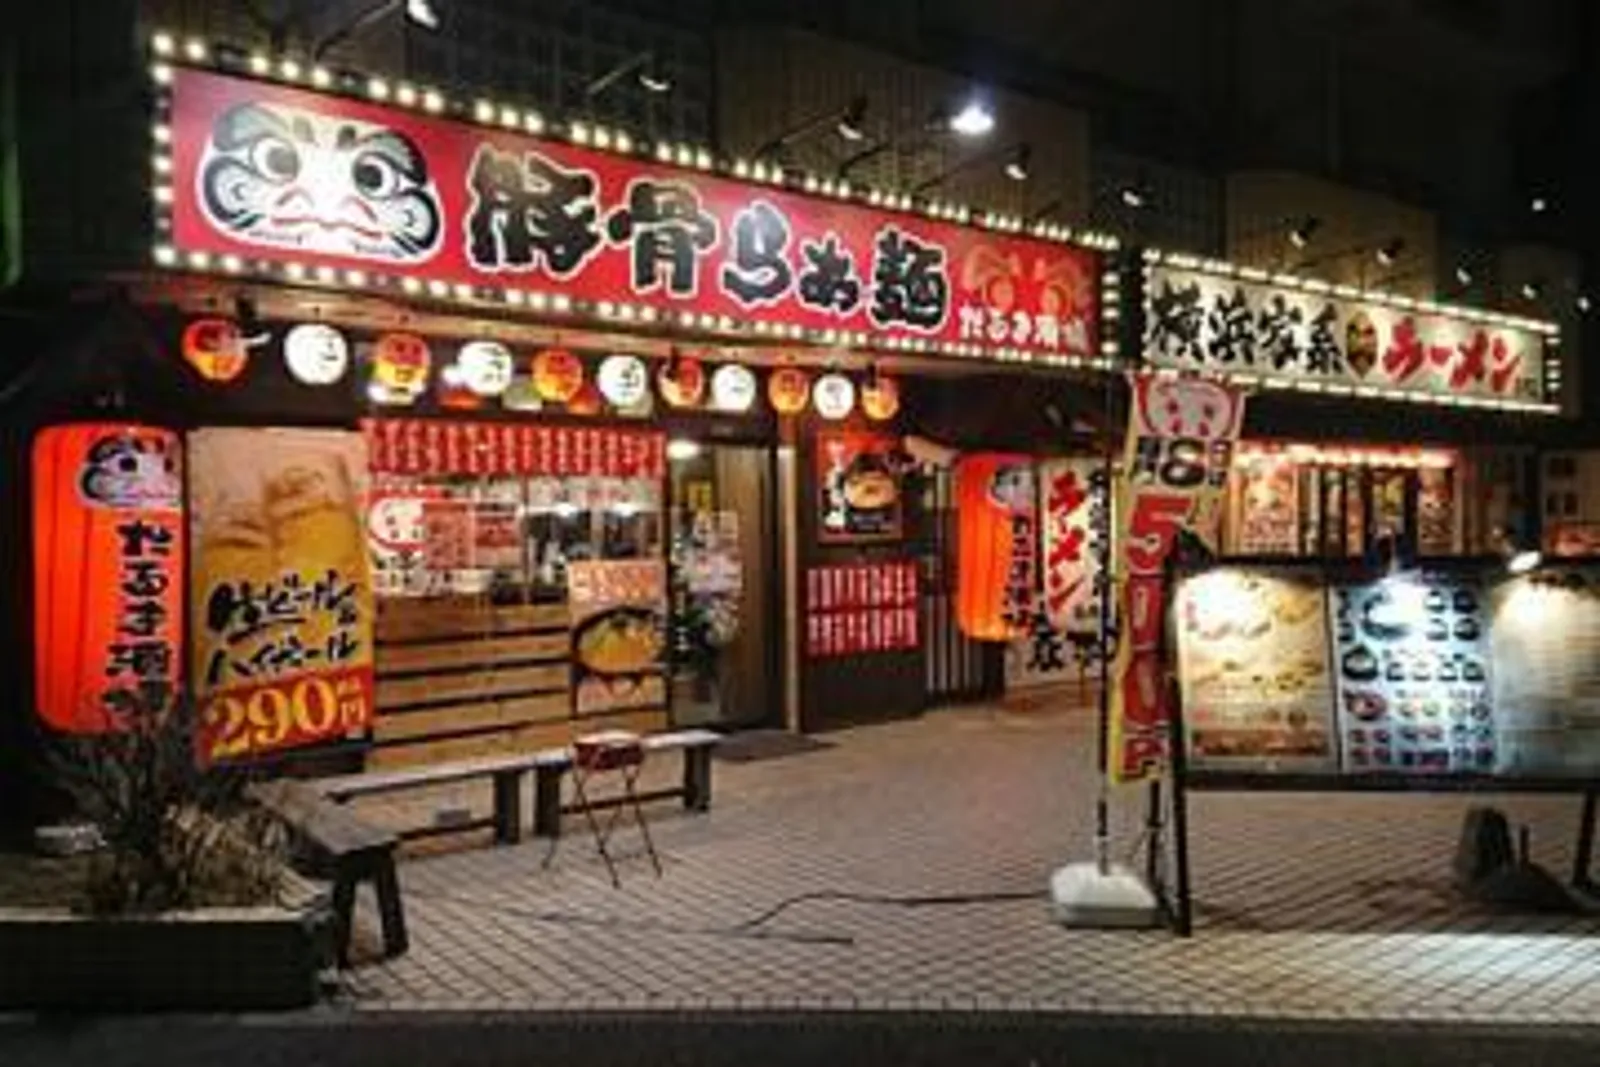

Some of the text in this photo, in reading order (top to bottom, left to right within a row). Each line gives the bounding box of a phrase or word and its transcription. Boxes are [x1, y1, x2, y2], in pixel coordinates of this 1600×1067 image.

[1150, 280, 1342, 373] 横浜家系
[1383, 316, 1523, 392] ラーメン
